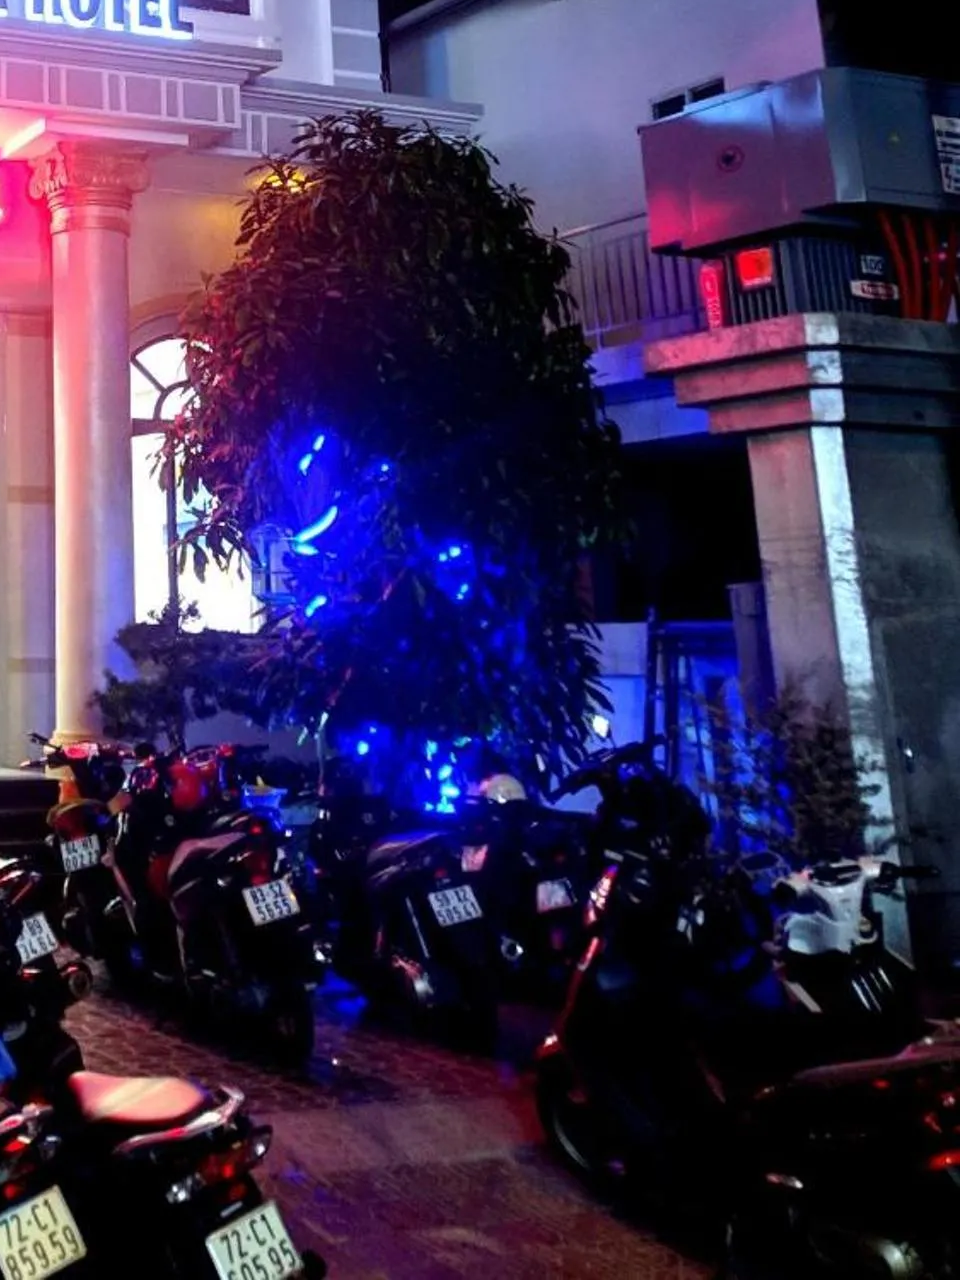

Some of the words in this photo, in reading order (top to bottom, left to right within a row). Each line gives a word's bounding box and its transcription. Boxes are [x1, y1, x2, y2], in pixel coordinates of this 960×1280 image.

[0, 1198, 58, 1249] 72-C1
[220, 1213, 277, 1265] 72-C1
[5, 1224, 81, 1280] 859.59
